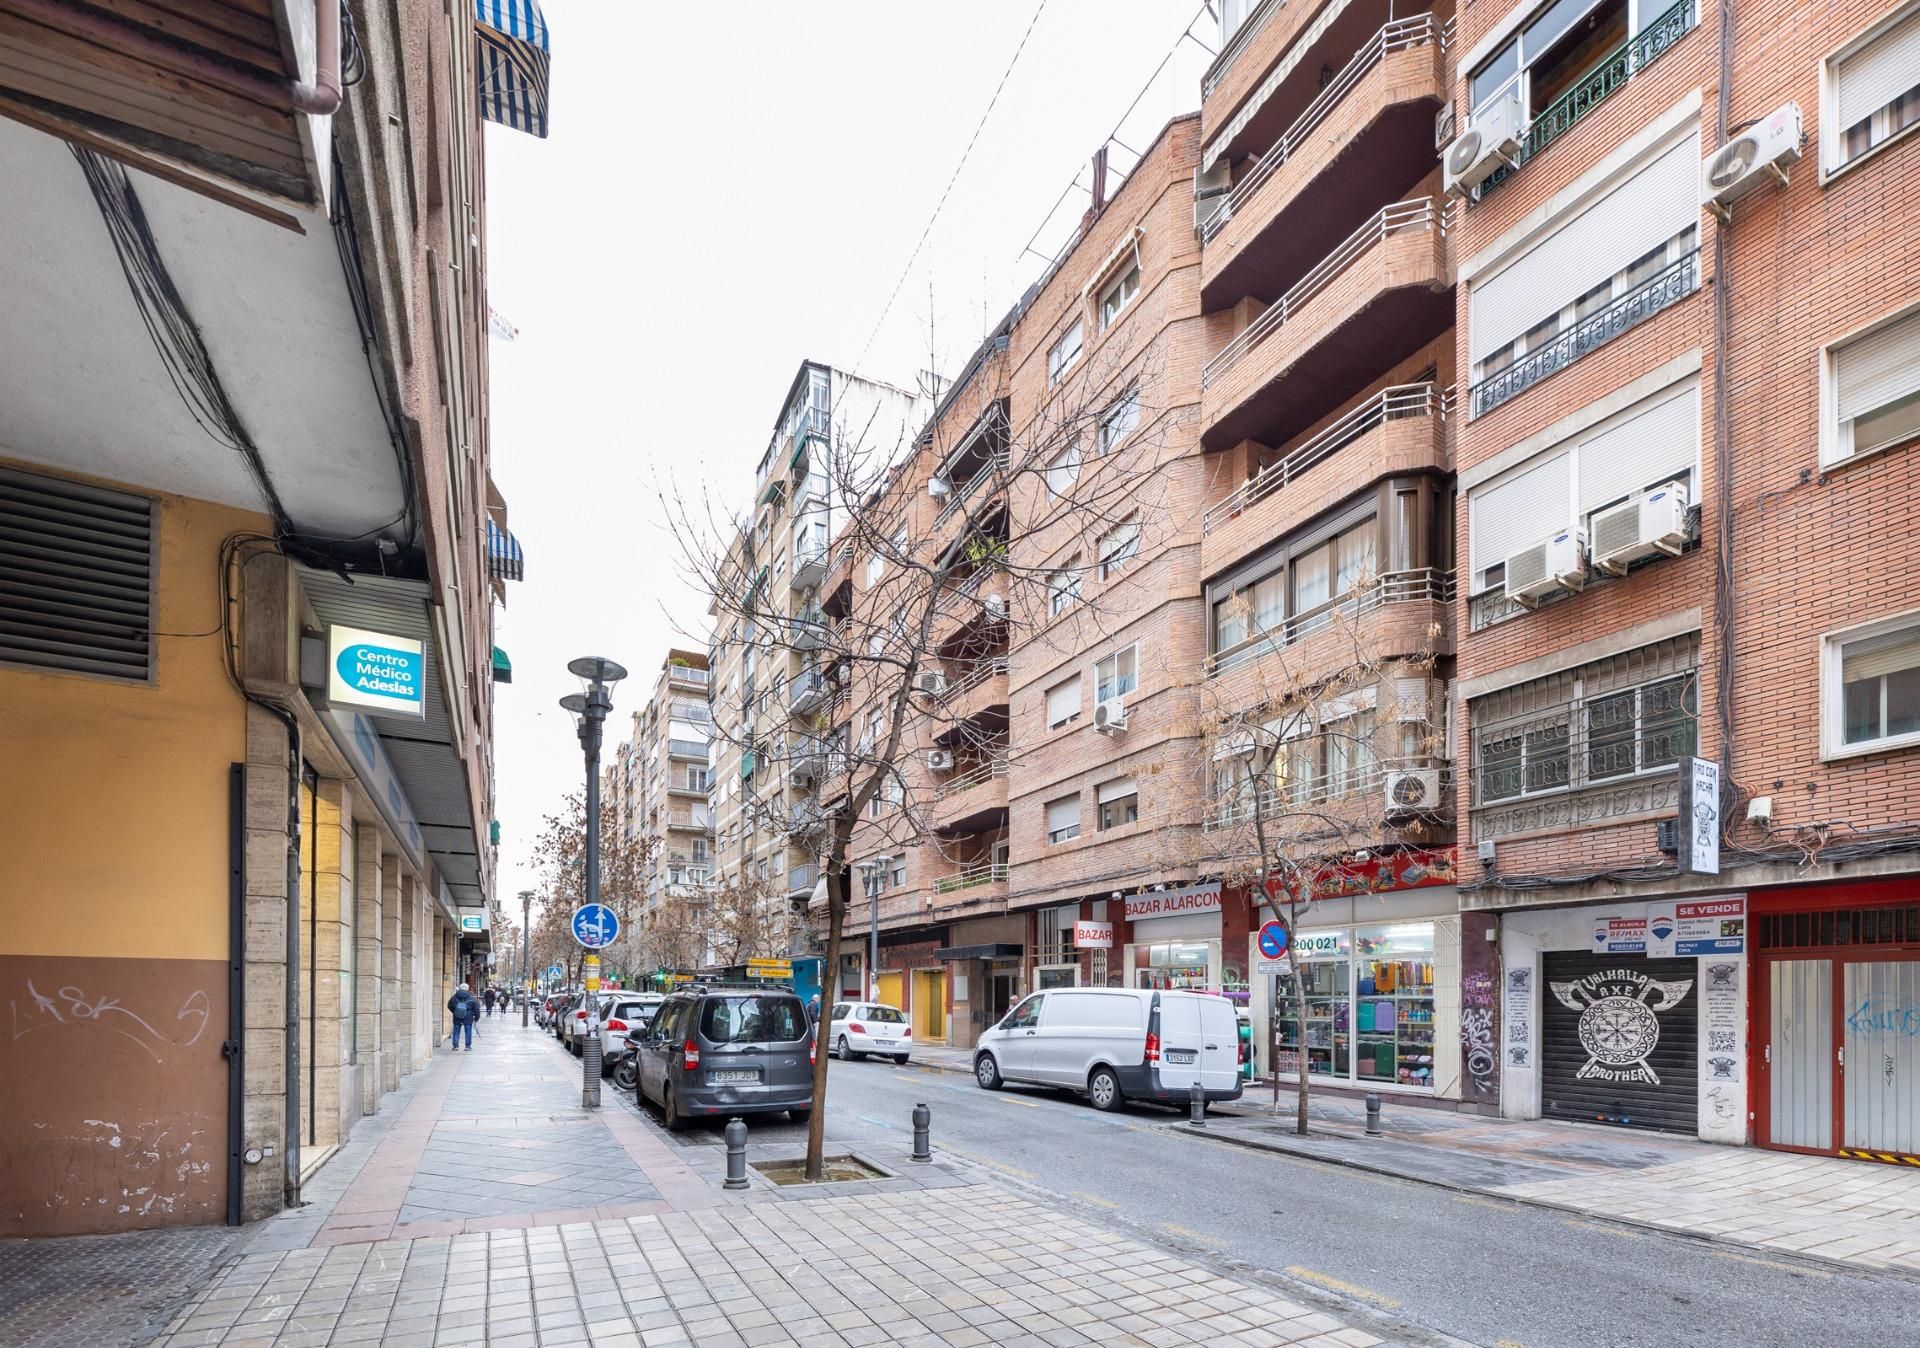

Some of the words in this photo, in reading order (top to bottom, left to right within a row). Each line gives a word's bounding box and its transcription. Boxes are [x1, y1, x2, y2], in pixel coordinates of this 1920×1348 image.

[357, 649, 409, 668] Centro
[356, 662, 412, 682] Médico
[357, 676, 414, 696] Adeslas
[1125, 901, 1160, 916] BAZAR
[1163, 891, 1222, 912] ALARCON
[1679, 907, 1695, 915] SE
[1698, 904, 1741, 914] VENDE
[1078, 929, 1112, 941] BAZAR
[1316, 937, 1337, 949] 021
[1581, 969, 1648, 991] VALHALLA
[1600, 985, 1634, 997] AXE
[717, 1071, 738, 1080] 8351
[1583, 1065, 1652, 1083] BROTHER
